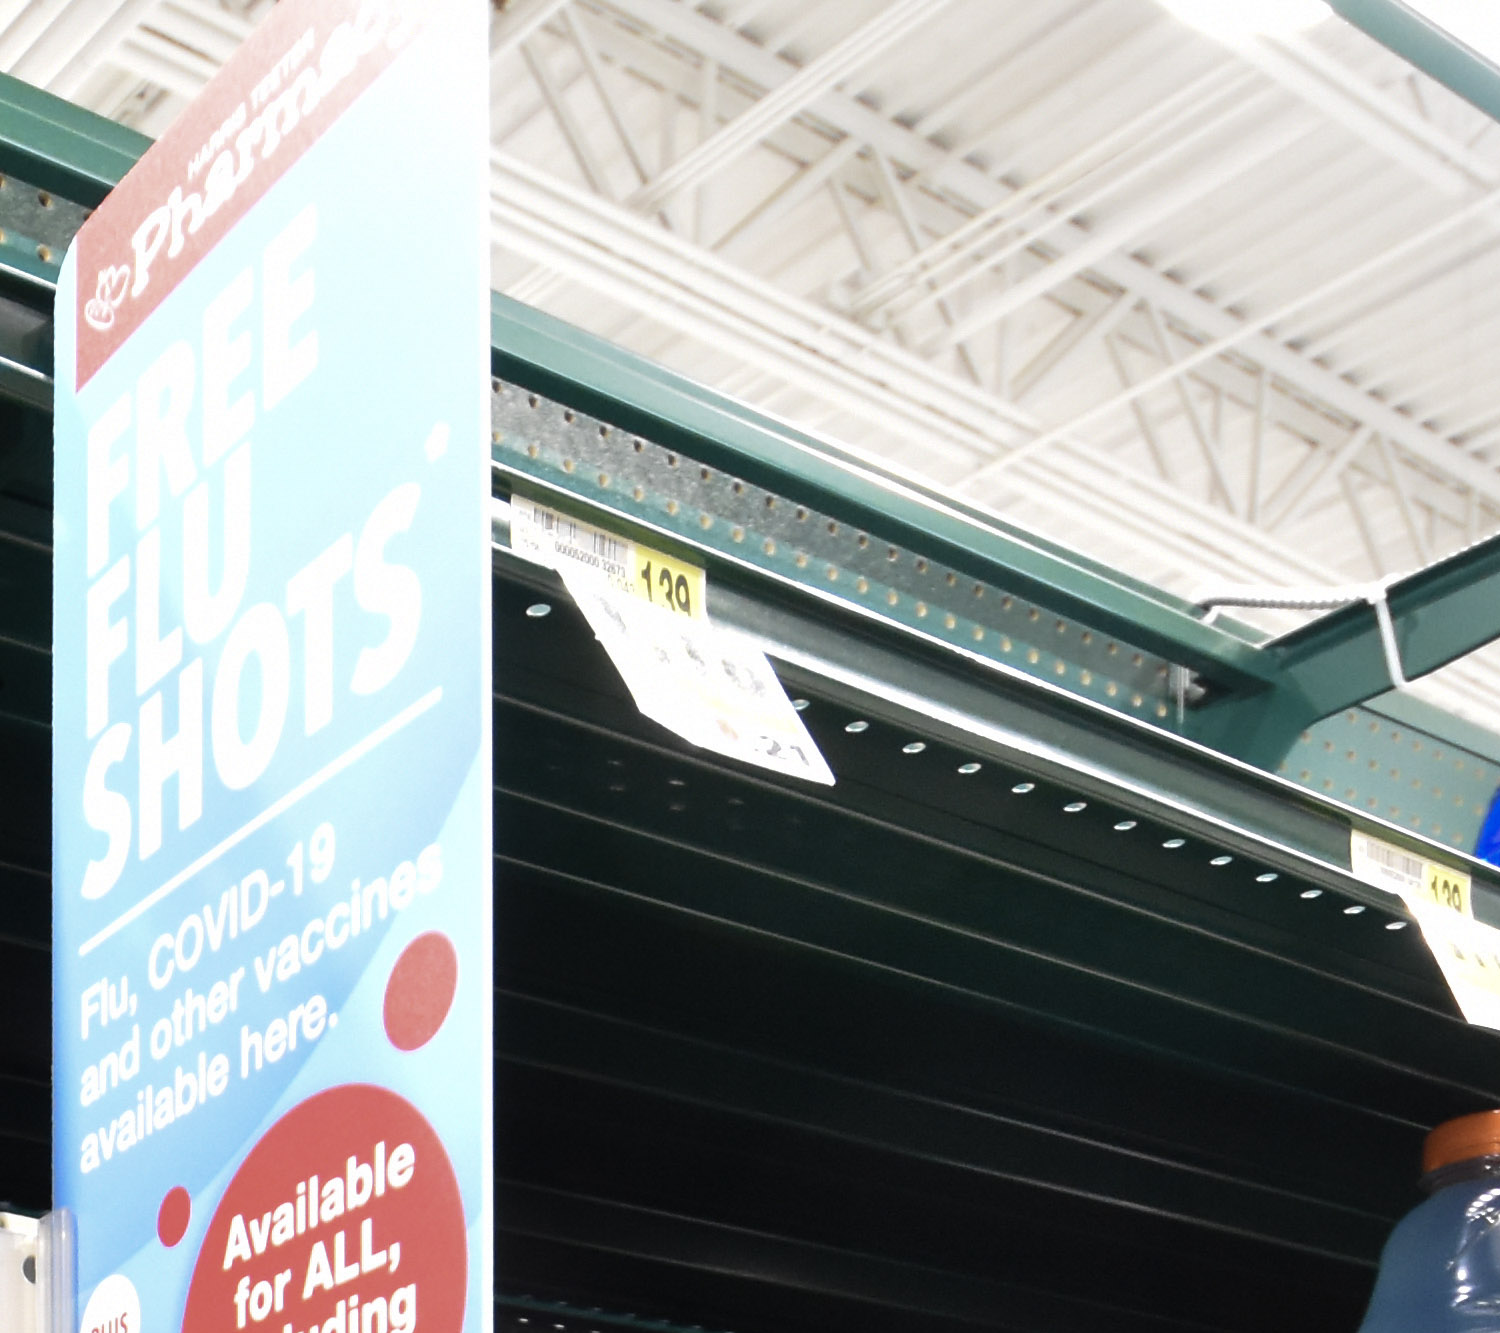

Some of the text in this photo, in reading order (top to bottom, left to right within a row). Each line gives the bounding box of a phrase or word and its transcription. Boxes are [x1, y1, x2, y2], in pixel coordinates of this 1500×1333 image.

[87, 203, 318, 578] FREE
[86, 441, 252, 740] FLU
[81, 821, 336, 1040] Flu, COVID-19
[81, 843, 443, 1107] and other vaccines
[81, 994, 338, 1174] available here.
[223, 1141, 416, 1269] Available
[234, 1218, 402, 1329] for ALL,
